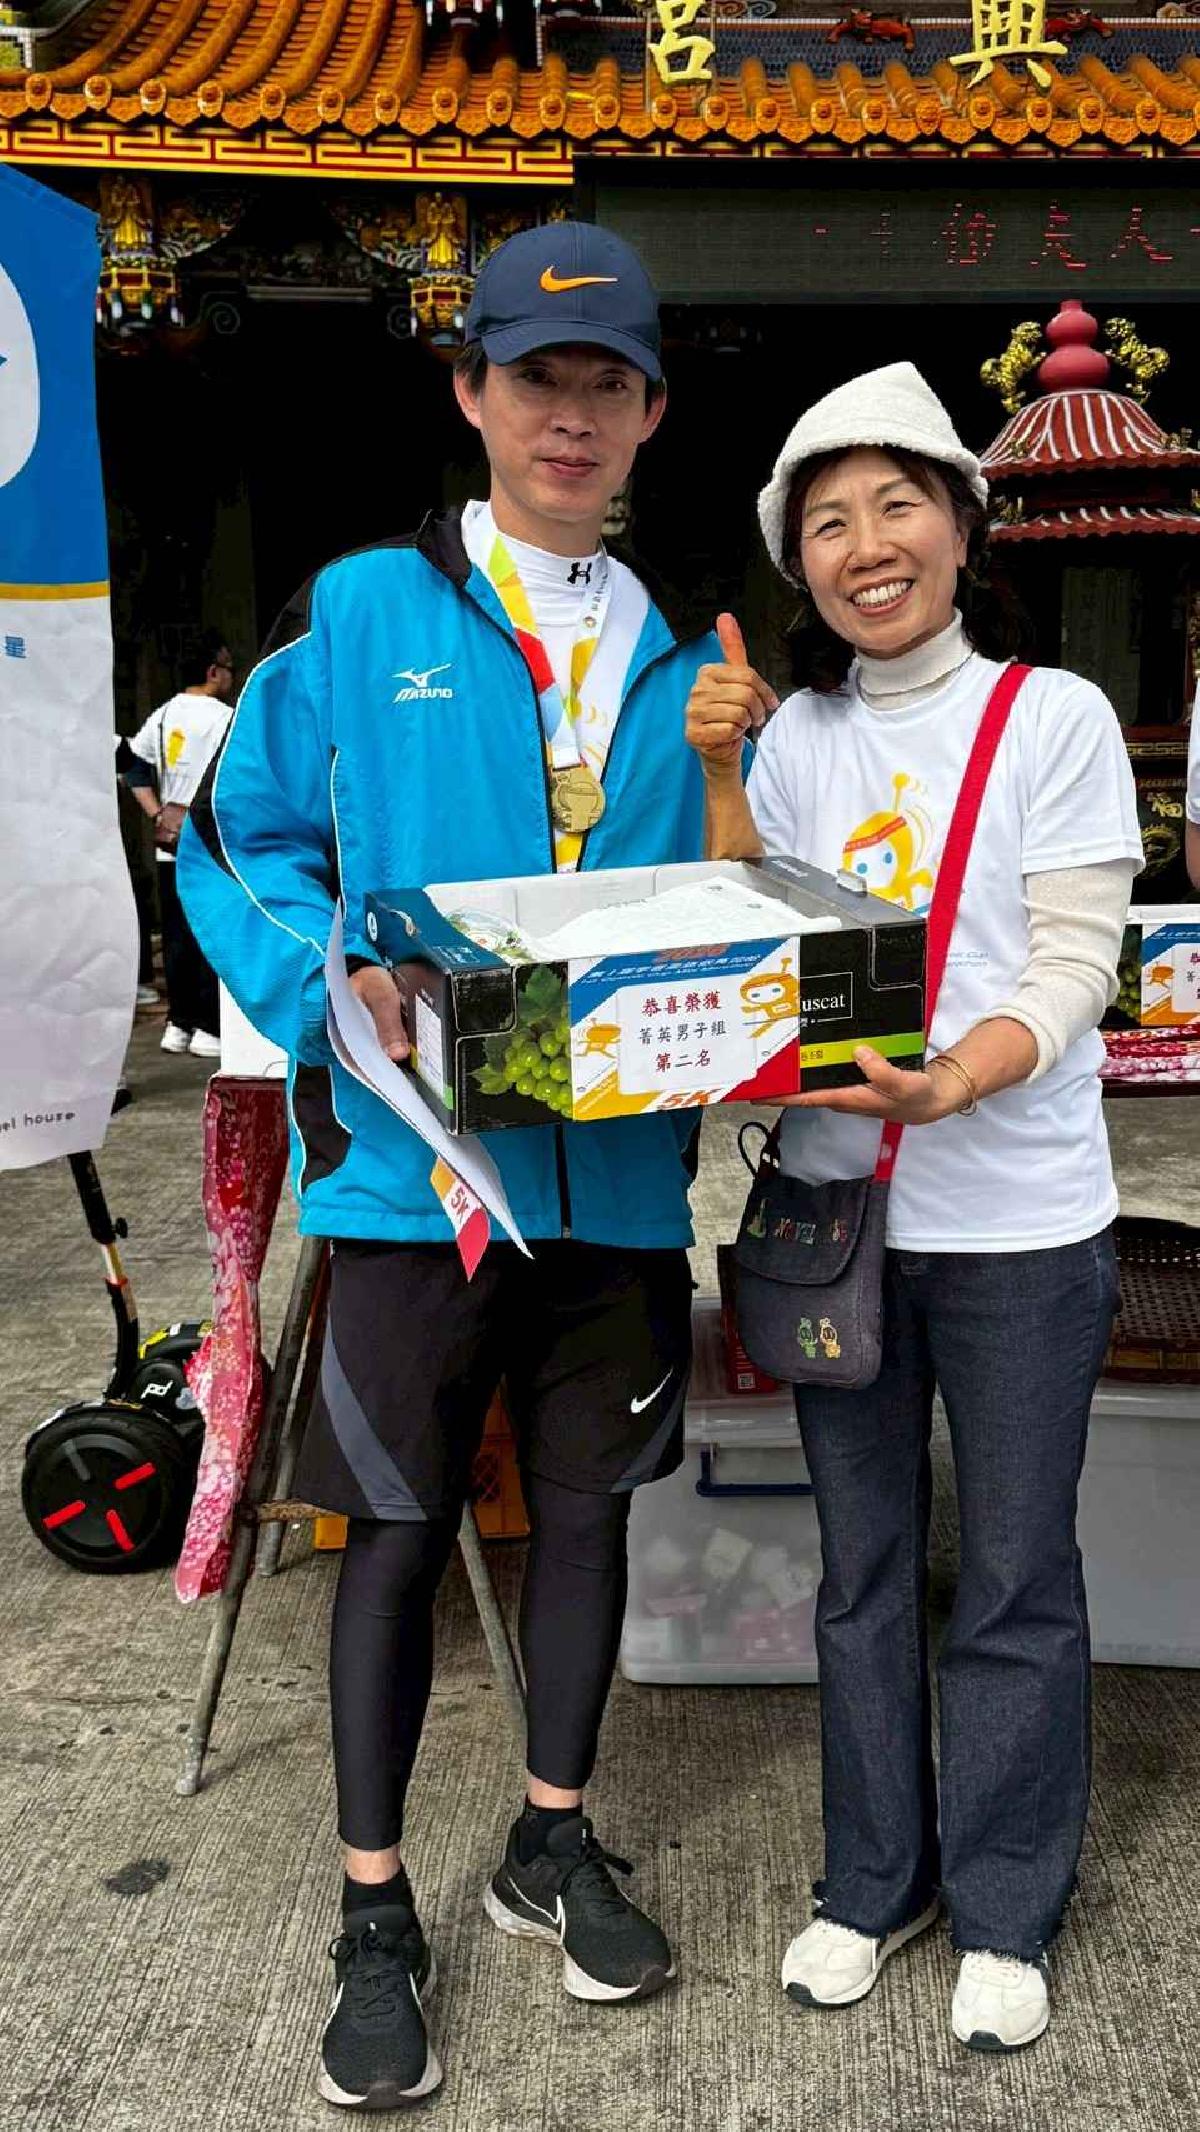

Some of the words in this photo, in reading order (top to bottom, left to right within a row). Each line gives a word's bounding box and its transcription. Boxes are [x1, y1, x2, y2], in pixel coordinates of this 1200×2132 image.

[642, 990, 721, 1017] 恭喜榮獲
[800, 993, 846, 1012] uscat
[639, 1020, 727, 1045] 菁英男子組
[655, 1049, 711, 1073] 第二名
[24, 1112, 76, 1127] house
